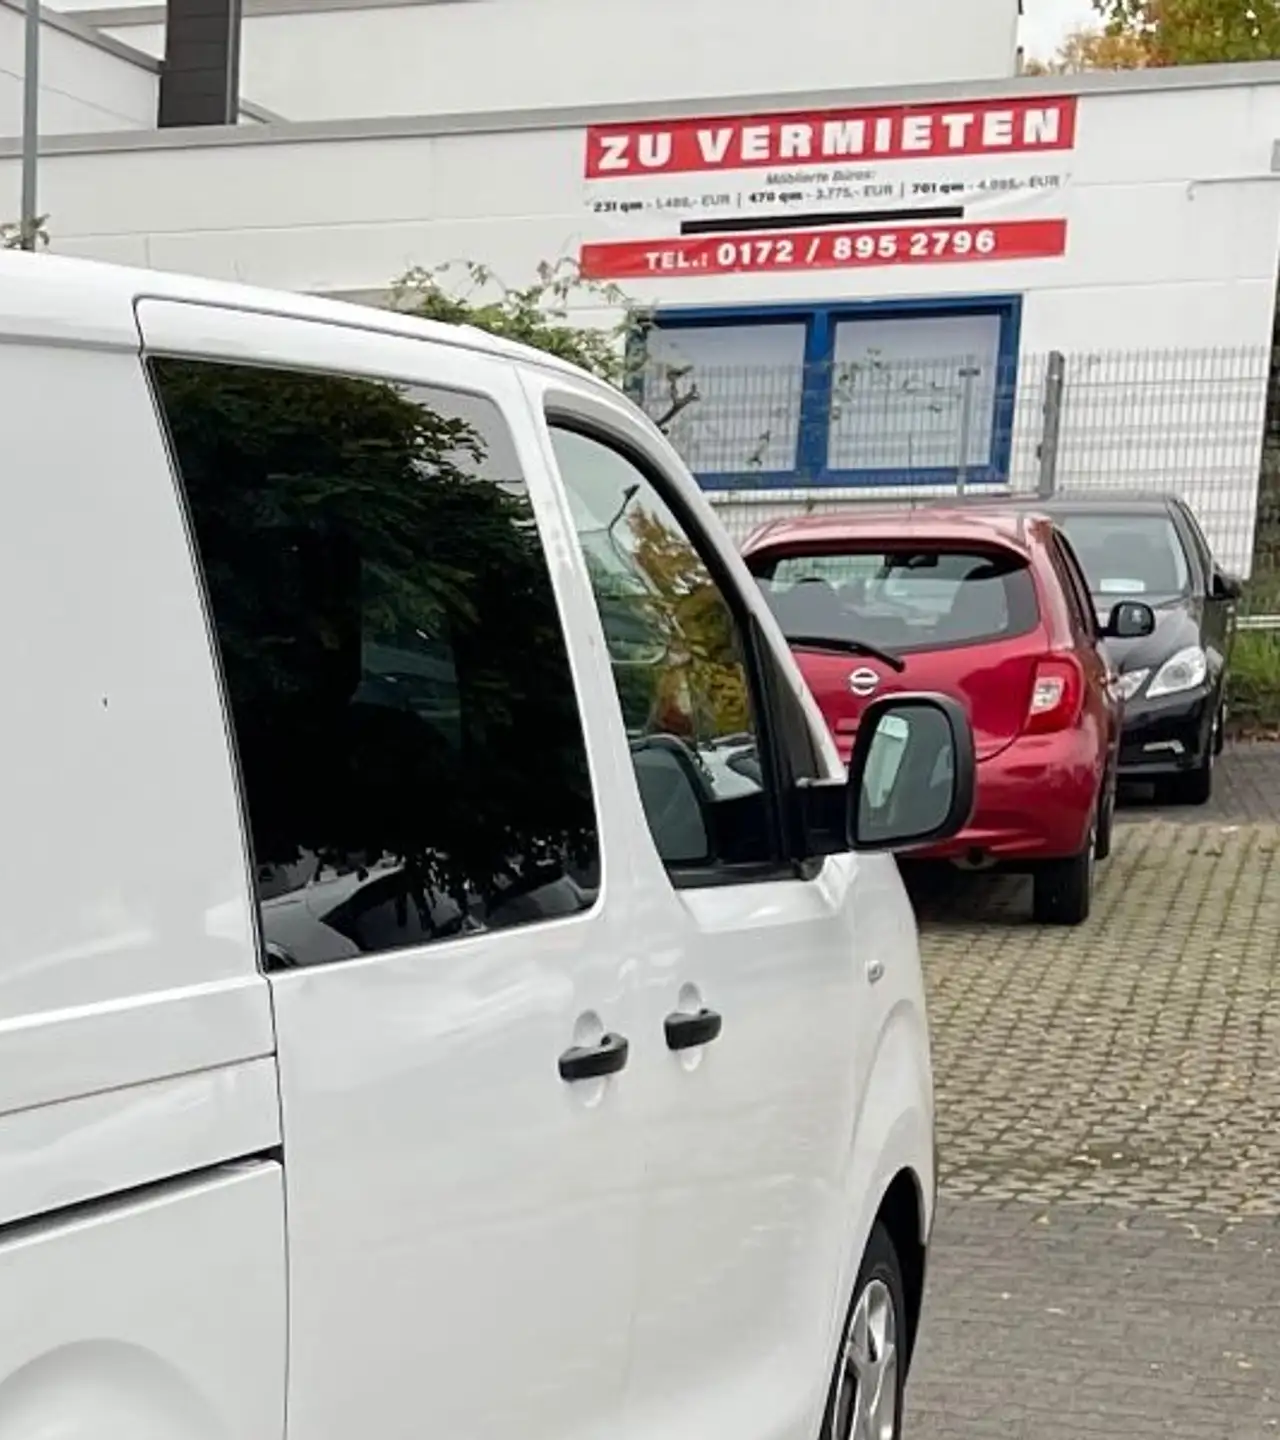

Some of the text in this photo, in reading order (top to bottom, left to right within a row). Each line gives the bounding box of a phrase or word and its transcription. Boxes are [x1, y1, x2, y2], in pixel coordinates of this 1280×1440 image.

[597, 107, 1061, 171] ZU VERMIETEN
[701, 193, 731, 207] EUR
[863, 184, 893, 197] EUR
[1029, 174, 1060, 189] EUR
[645, 251, 707, 270] TEL.:
[717, 239, 793, 268] 0172
[832, 234, 898, 261] 895
[910, 229, 996, 257] 2796
